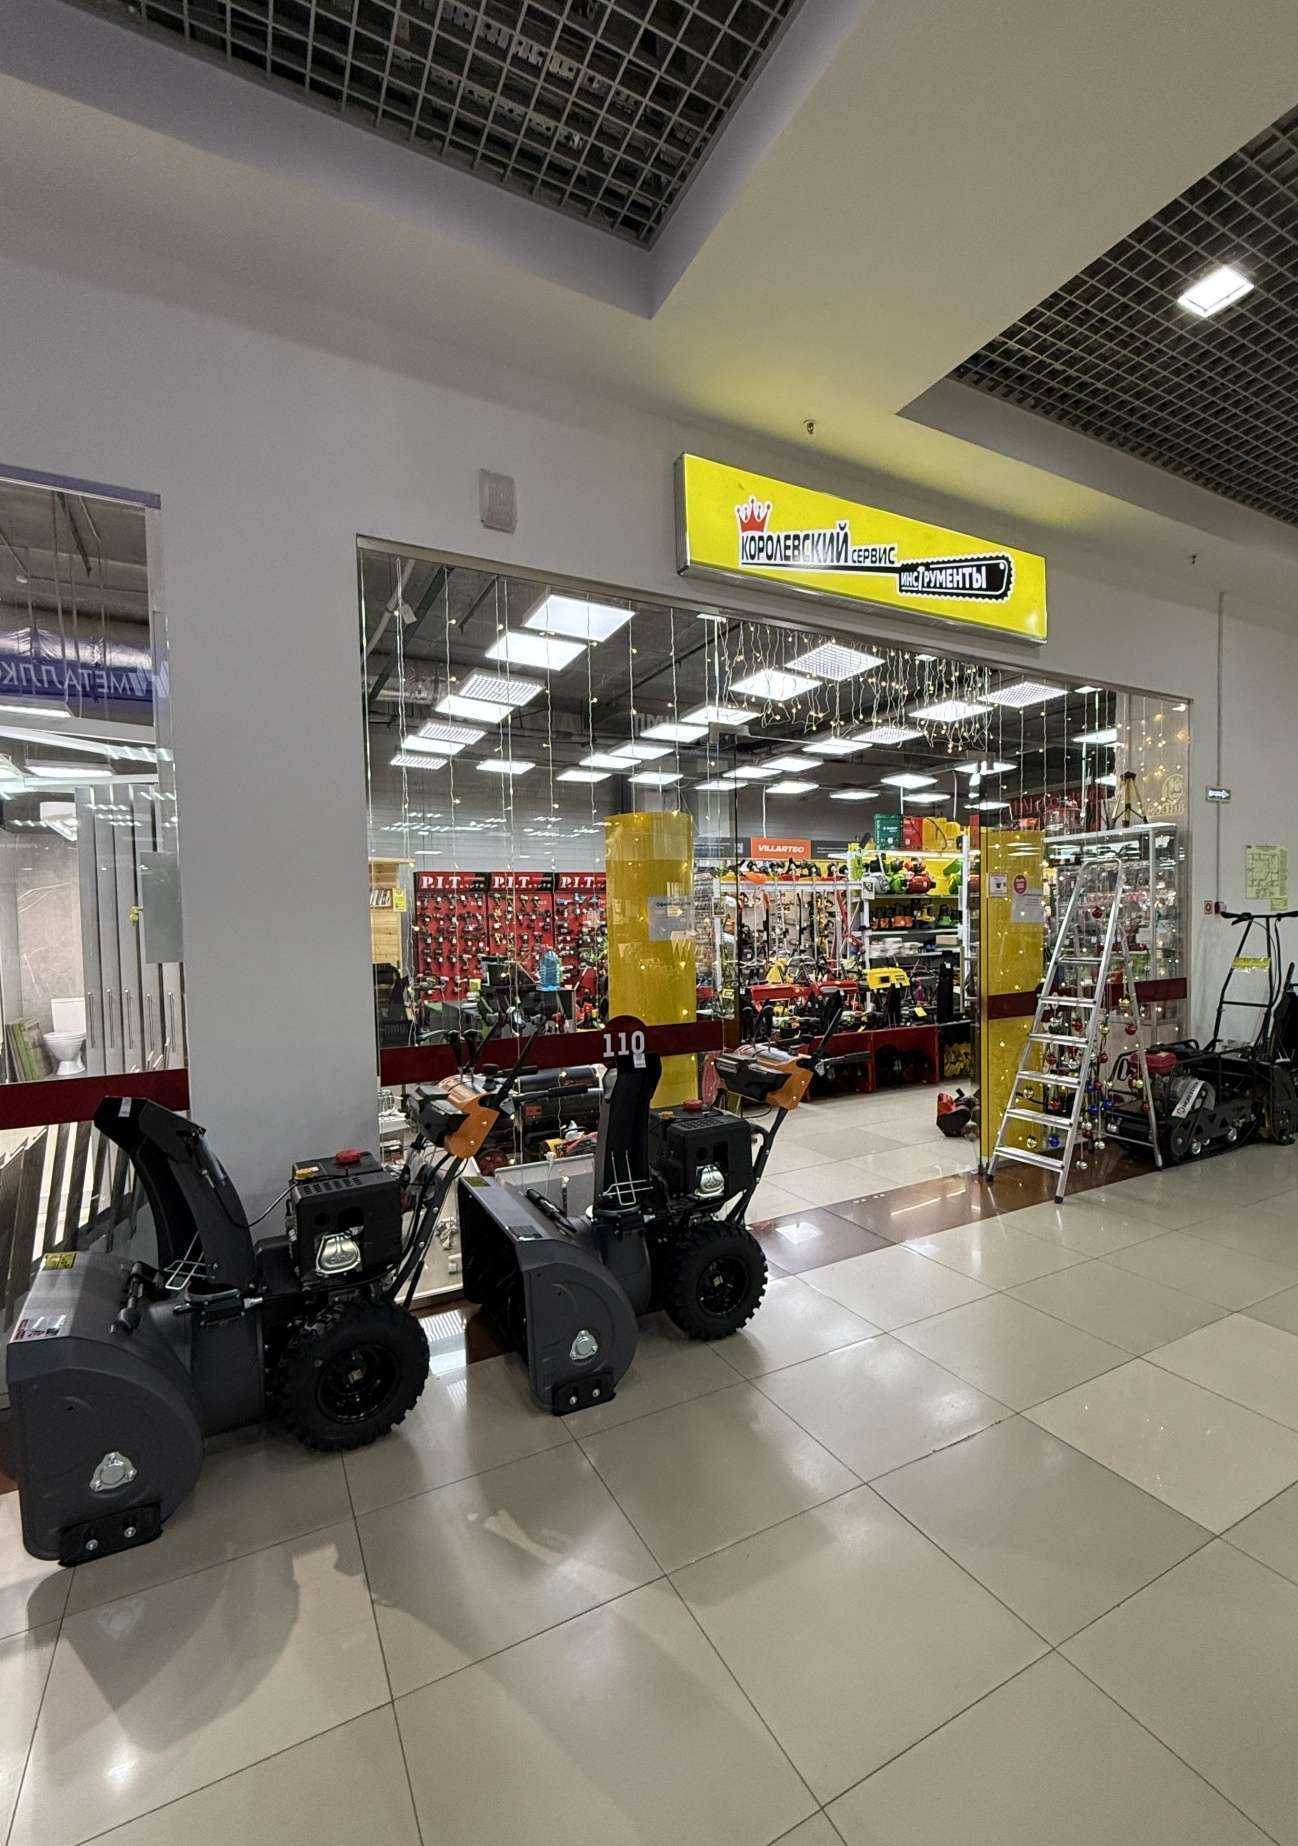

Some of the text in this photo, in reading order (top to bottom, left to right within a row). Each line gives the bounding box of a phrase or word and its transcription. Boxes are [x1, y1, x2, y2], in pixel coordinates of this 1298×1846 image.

[741, 522, 896, 565] КОРОЛЕВСКИЙ СЕРВИС
[900, 565, 987, 590] ИНСТРУМЕНТЫ
[603, 1030, 645, 1058] 110
